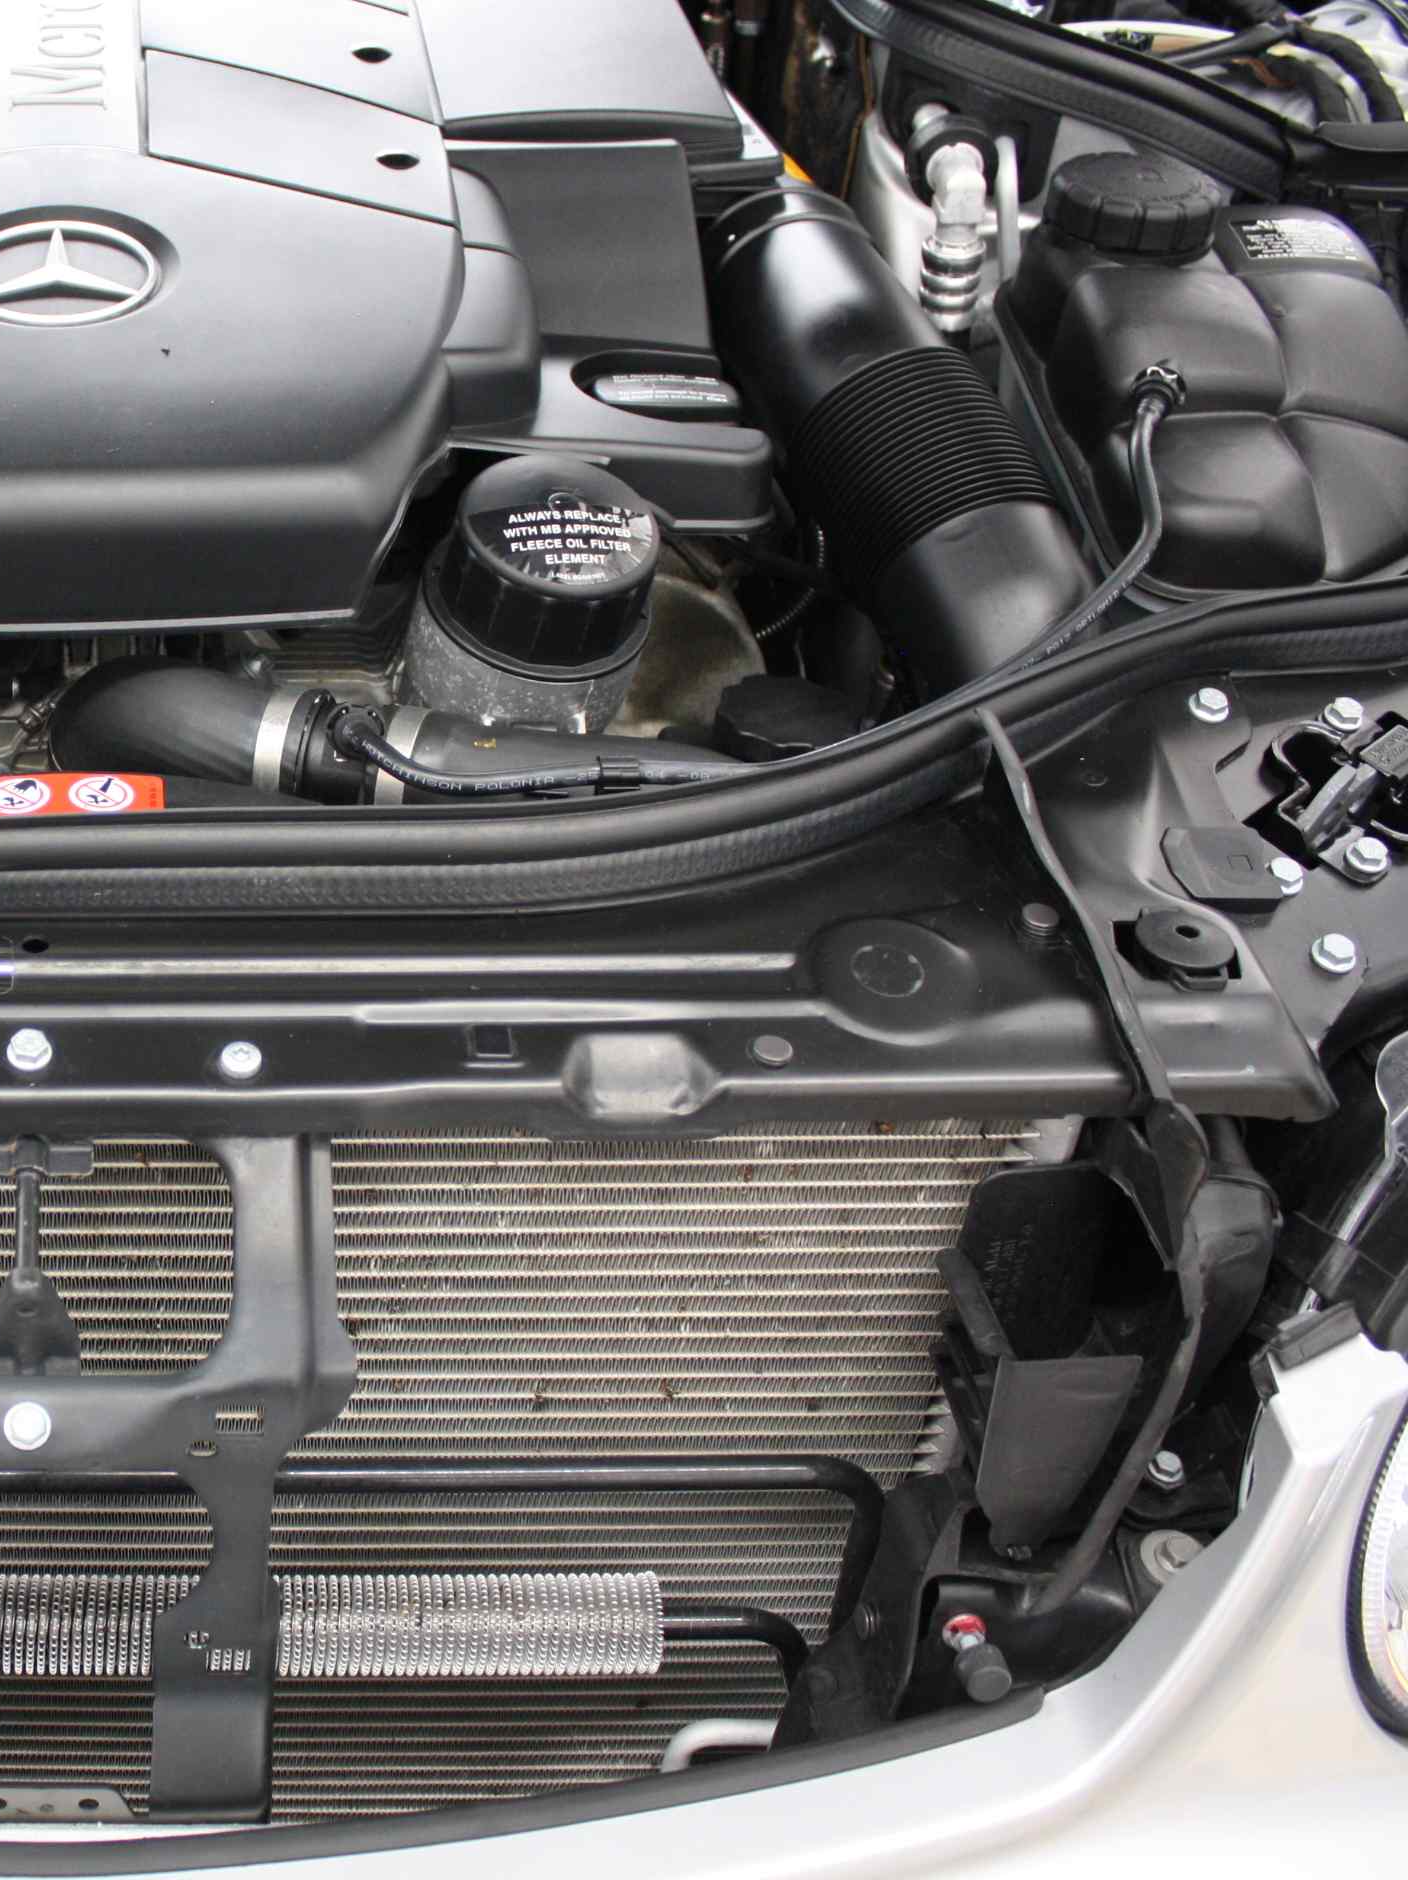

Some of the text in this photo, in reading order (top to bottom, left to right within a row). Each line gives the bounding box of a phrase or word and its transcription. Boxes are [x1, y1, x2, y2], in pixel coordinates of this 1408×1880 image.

[508, 509, 621, 524] ALWAYS REPLACE
[503, 524, 632, 538] WITH MB APPROVED
[510, 538, 632, 552] FLEECE OIL FILTER
[545, 554, 606, 565] ELEMENT
[361, 739, 462, 791] HUTCHINSON
[474, 775, 555, 791] POLONIA
